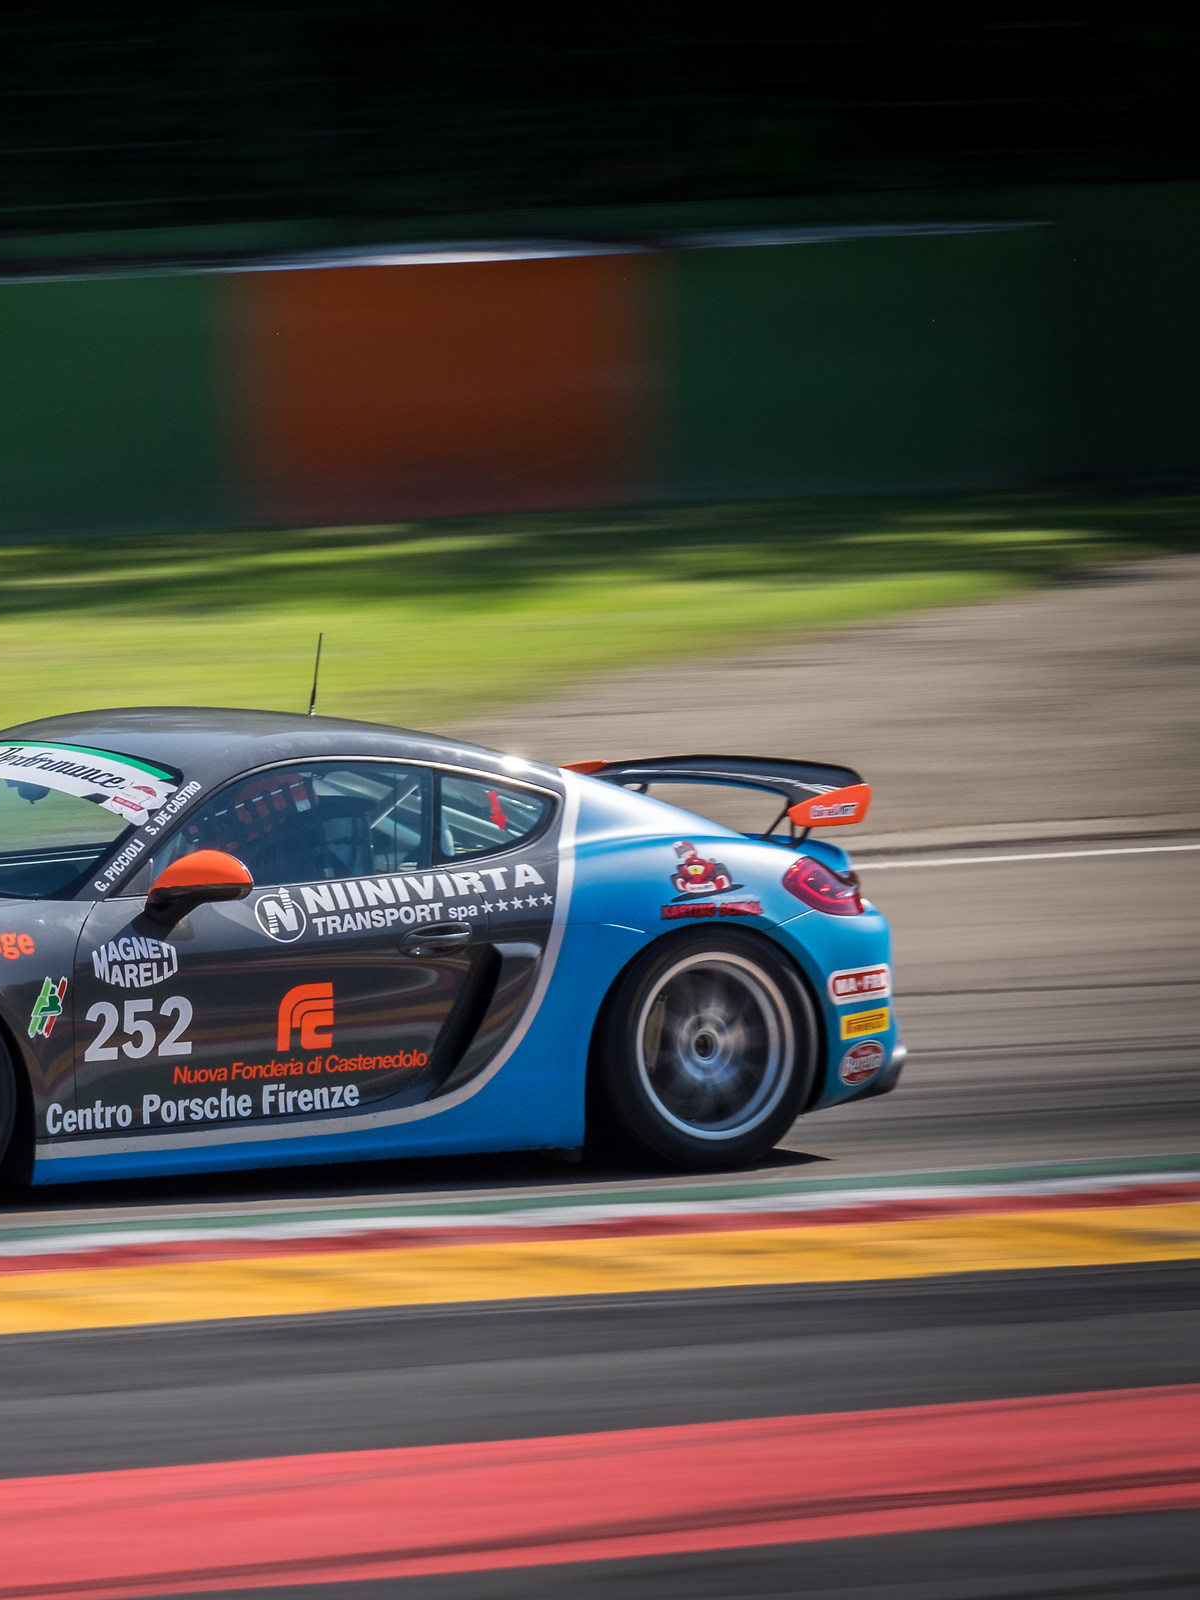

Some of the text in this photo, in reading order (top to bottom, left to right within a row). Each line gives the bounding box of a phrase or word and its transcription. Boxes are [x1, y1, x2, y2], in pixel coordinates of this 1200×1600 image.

[144, 780, 202, 836] S. DE CASTRO
[94, 880, 110, 892] G.
[103, 838, 146, 881] PICCIOLI
[300, 864, 546, 914] NIINIVIRTA
[312, 902, 479, 936] TRANSPORT spa
[84, 995, 193, 1062] 252
[173, 1049, 428, 1085] Nuova Fonderia di Castenedolo
[46, 1083, 360, 1136] Centro Porsche Firenze
